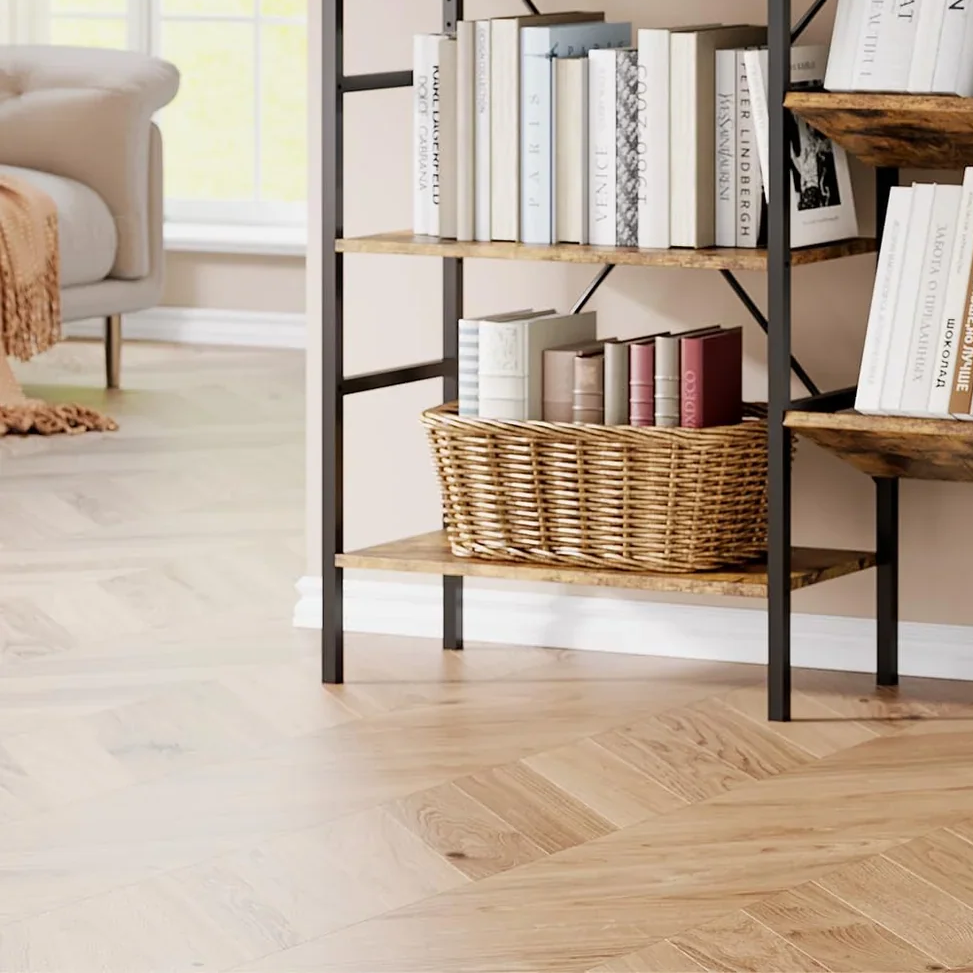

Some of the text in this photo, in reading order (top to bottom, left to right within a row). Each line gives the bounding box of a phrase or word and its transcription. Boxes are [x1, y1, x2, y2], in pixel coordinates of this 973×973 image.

[528, 93, 540, 208] PARIS
[594, 143, 608, 222] VENICE
[740, 129, 751, 237] LINDBERGH
[935, 317, 956, 389] ШОКОЛАД
